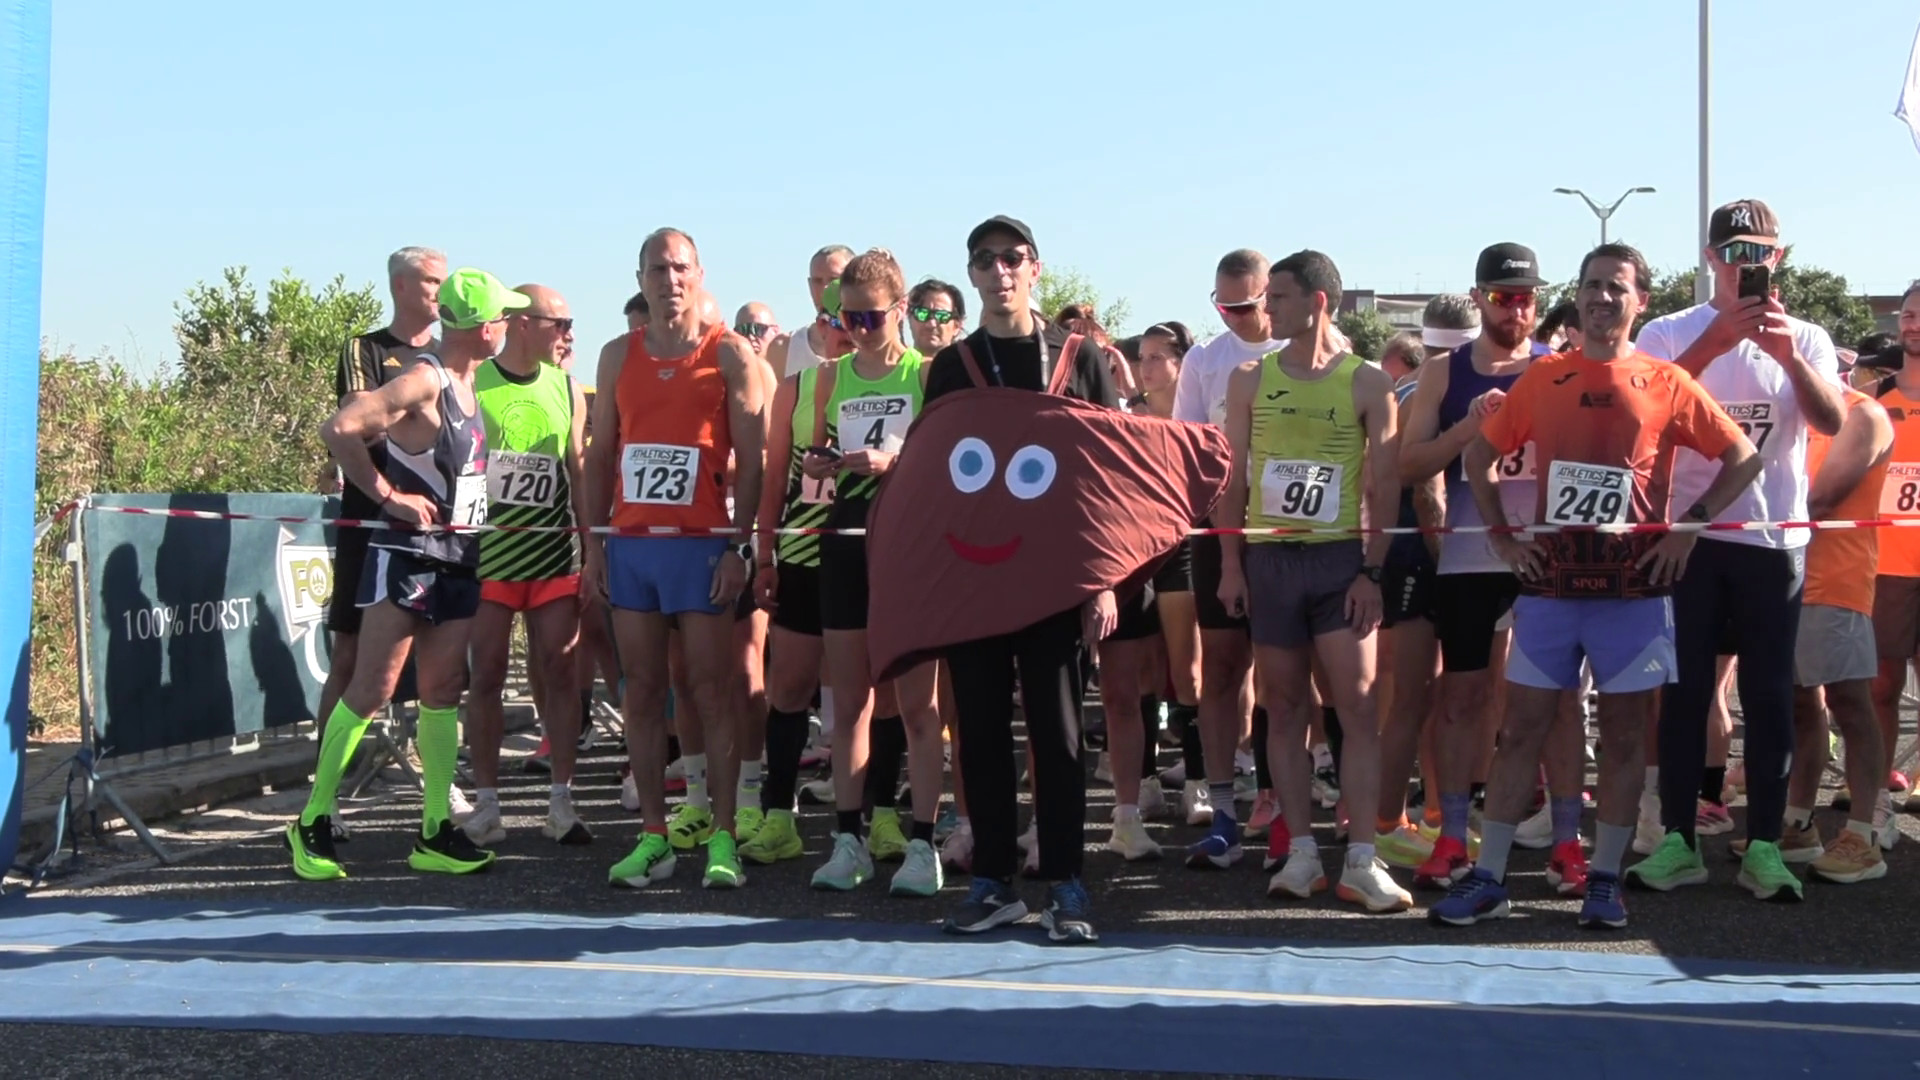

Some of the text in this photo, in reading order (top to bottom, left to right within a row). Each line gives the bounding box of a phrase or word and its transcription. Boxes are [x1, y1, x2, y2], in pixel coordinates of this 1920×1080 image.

[864, 418, 885, 450] 4
[631, 449, 673, 461] ATHLETICS
[501, 472, 553, 503] 120
[634, 466, 690, 501] 123
[1558, 466, 1606, 481] ATHLETICS
[1281, 481, 1324, 516] 90
[1554, 485, 1622, 524] 249
[289, 557, 335, 608] FO
[1572, 577, 1608, 590] SPQR
[123, 597, 258, 641] 100% FORST.
